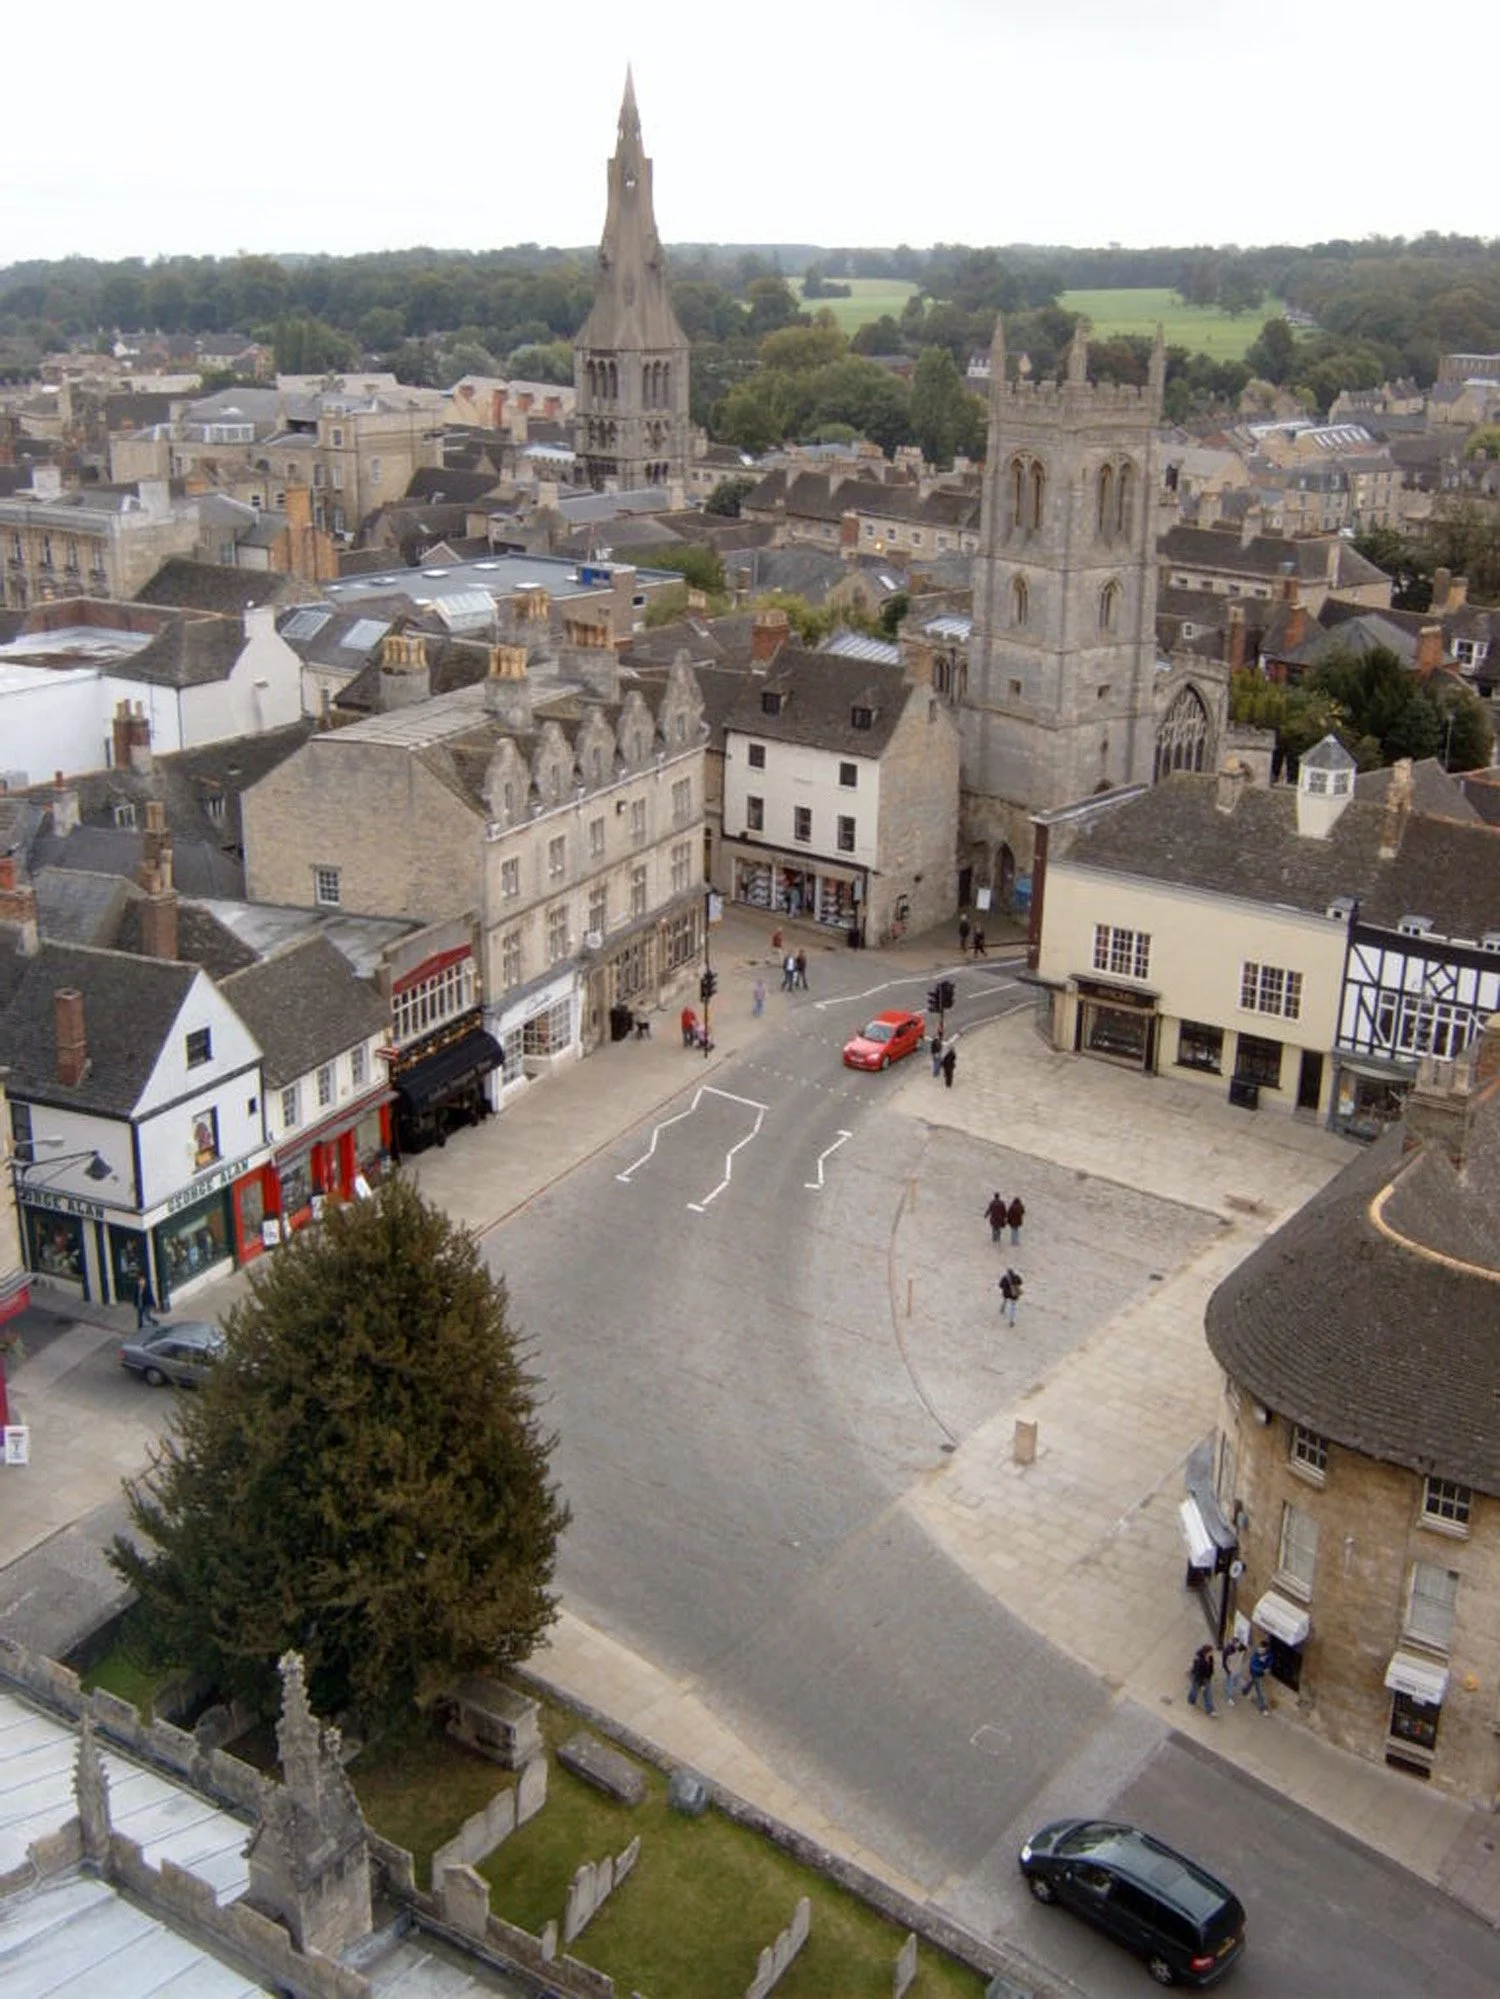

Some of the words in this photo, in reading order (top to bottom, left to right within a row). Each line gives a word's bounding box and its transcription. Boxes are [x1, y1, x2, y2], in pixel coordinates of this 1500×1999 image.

[167, 1178, 214, 1212] GEORGE
[220, 1159, 249, 1183] ALAN
[67, 1197, 105, 1219] ALAN
